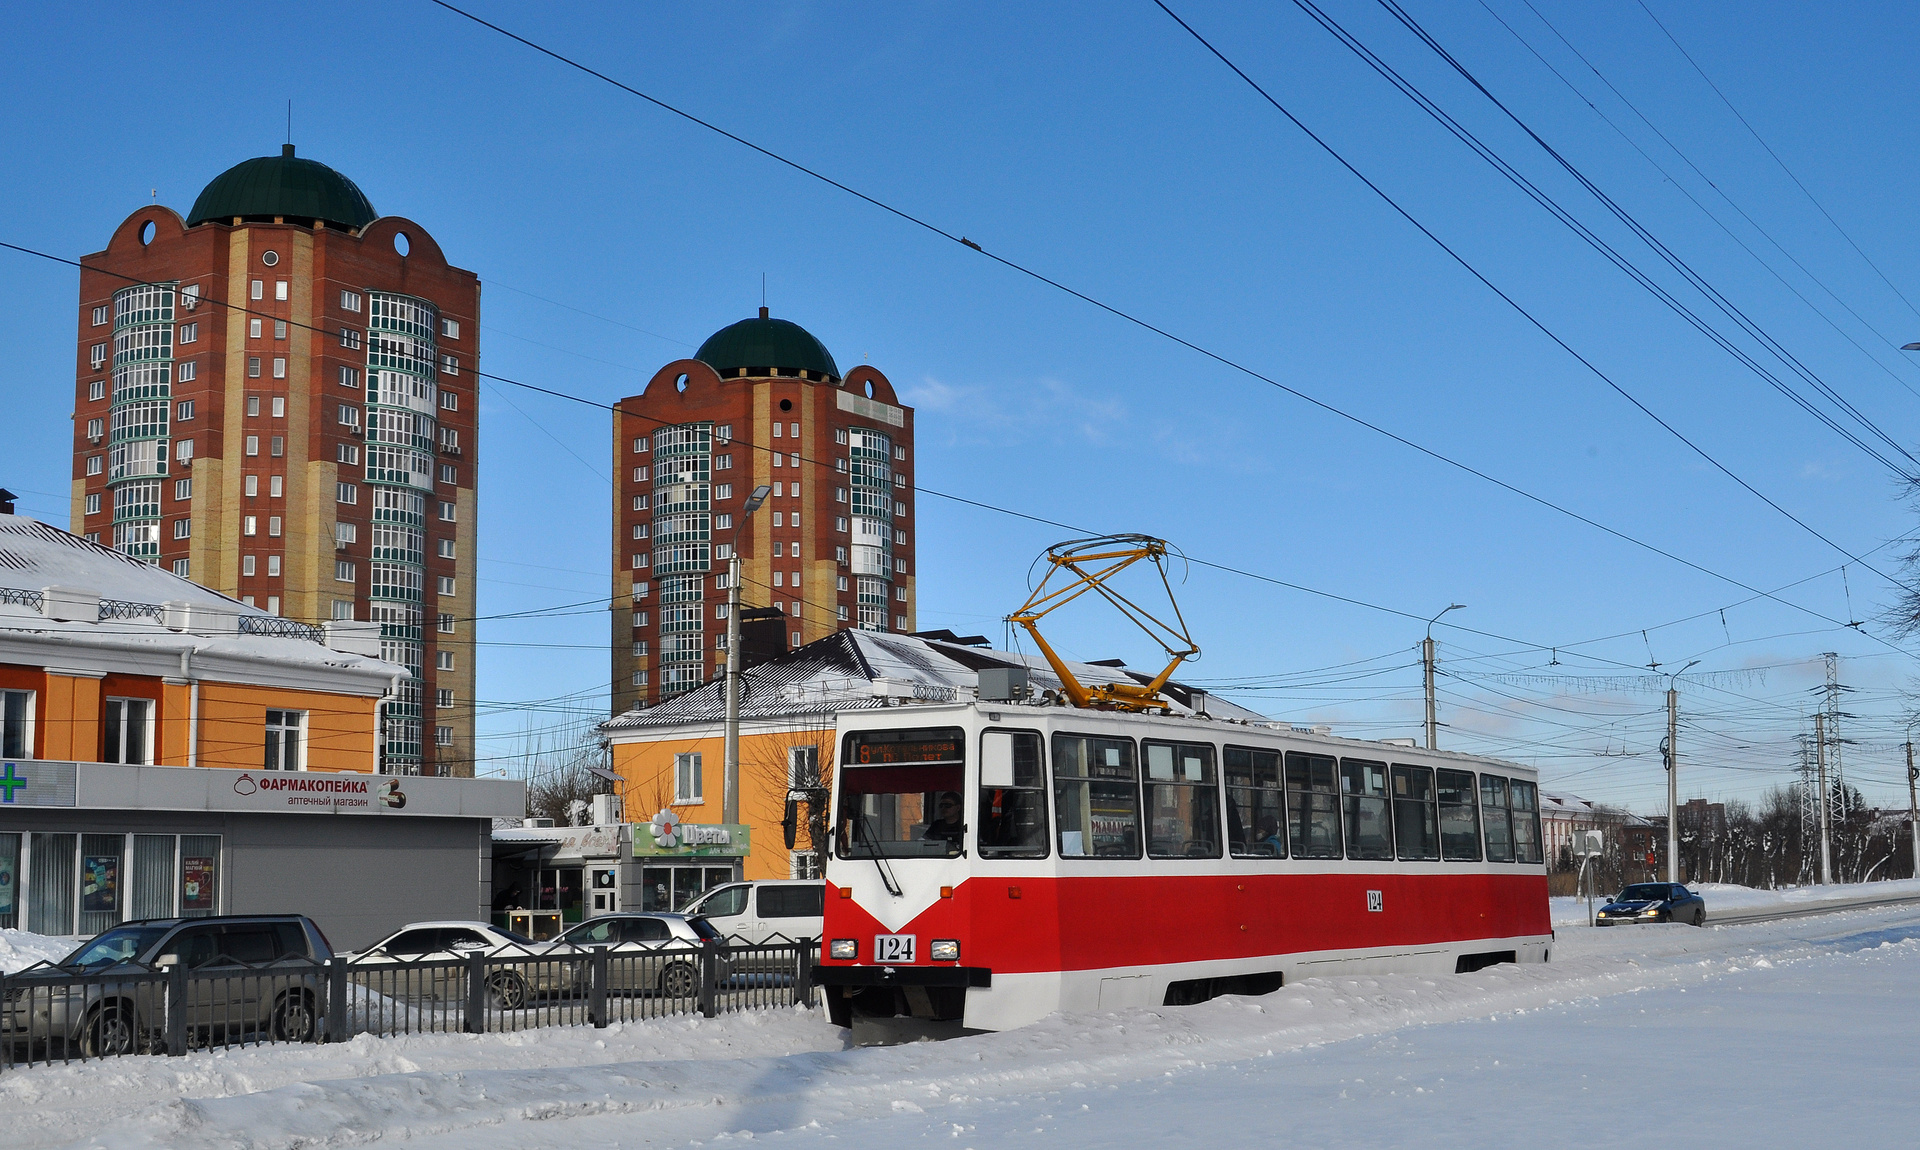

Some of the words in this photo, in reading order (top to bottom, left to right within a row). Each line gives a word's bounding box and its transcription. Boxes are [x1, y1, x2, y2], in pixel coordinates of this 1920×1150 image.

[259, 778, 368, 794] ФАРМАКОПЕЙКА
[287, 796, 332, 807] аптечный
[333, 799, 368, 807] магазин
[682, 824, 730, 845] Цветы
[1368, 892, 1382, 910] 124
[877, 937, 913, 960] 124
